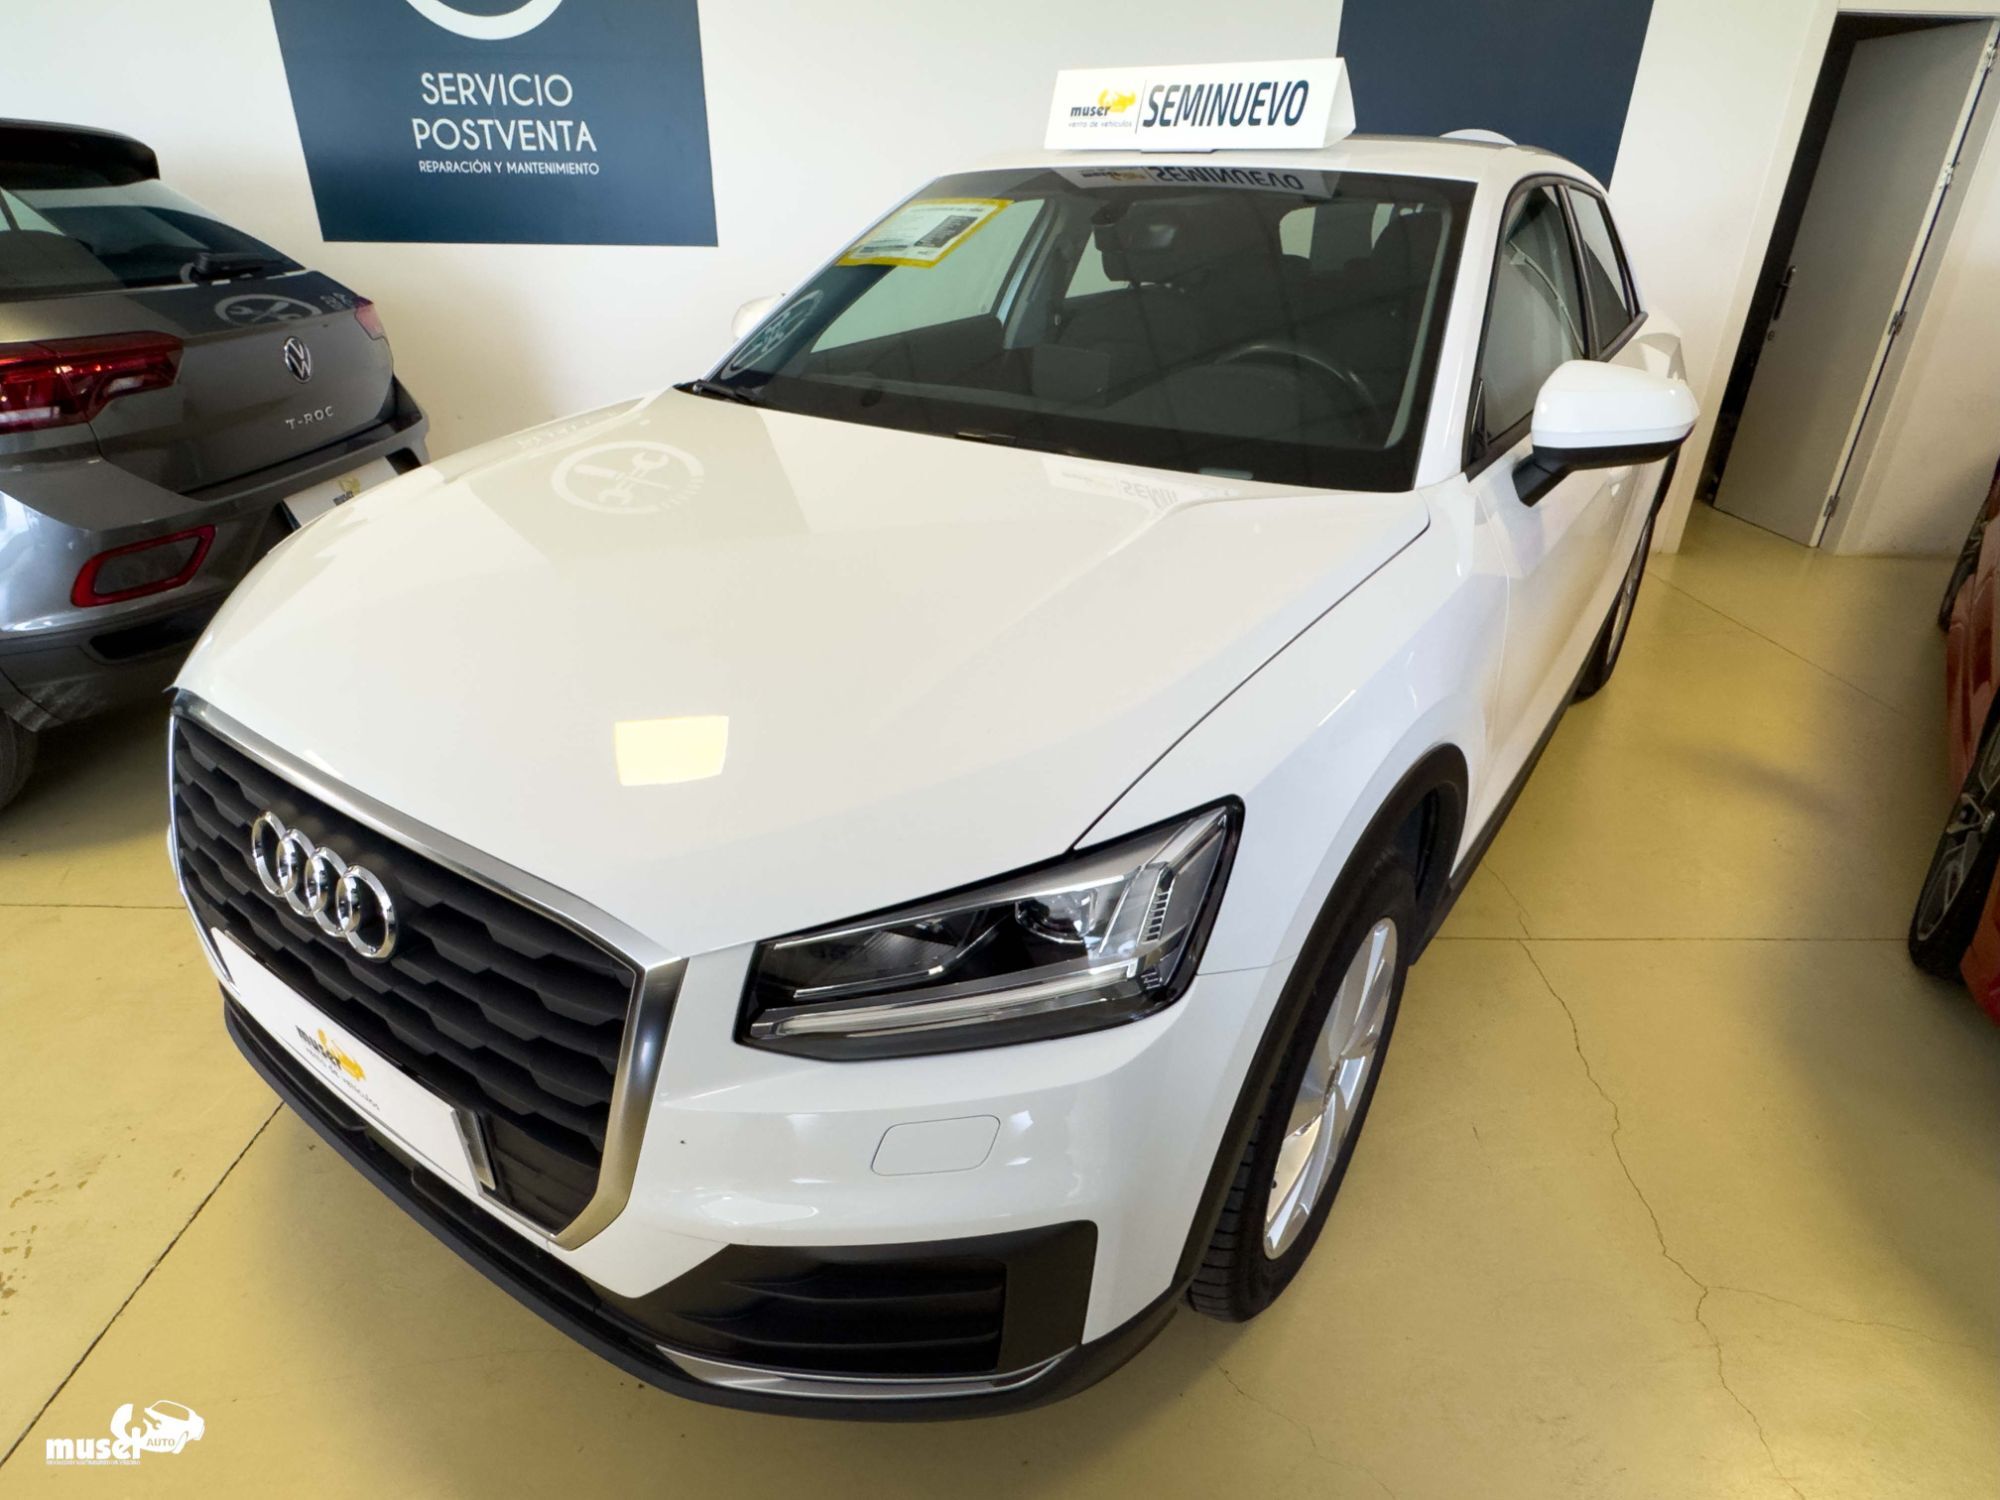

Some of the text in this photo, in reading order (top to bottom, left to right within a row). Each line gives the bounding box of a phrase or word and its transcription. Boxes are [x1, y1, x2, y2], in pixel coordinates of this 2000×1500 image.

[421, 72, 573, 107] SERVICIO
[1142, 79, 1309, 127] SEMINUEVO
[1070, 106, 1111, 117] muser
[411, 118, 598, 152] POSTVENTA
[418, 159, 600, 175] REPARACIÓN Y MANTENIMIENTO
[285, 406, 334, 430] T-ROC
